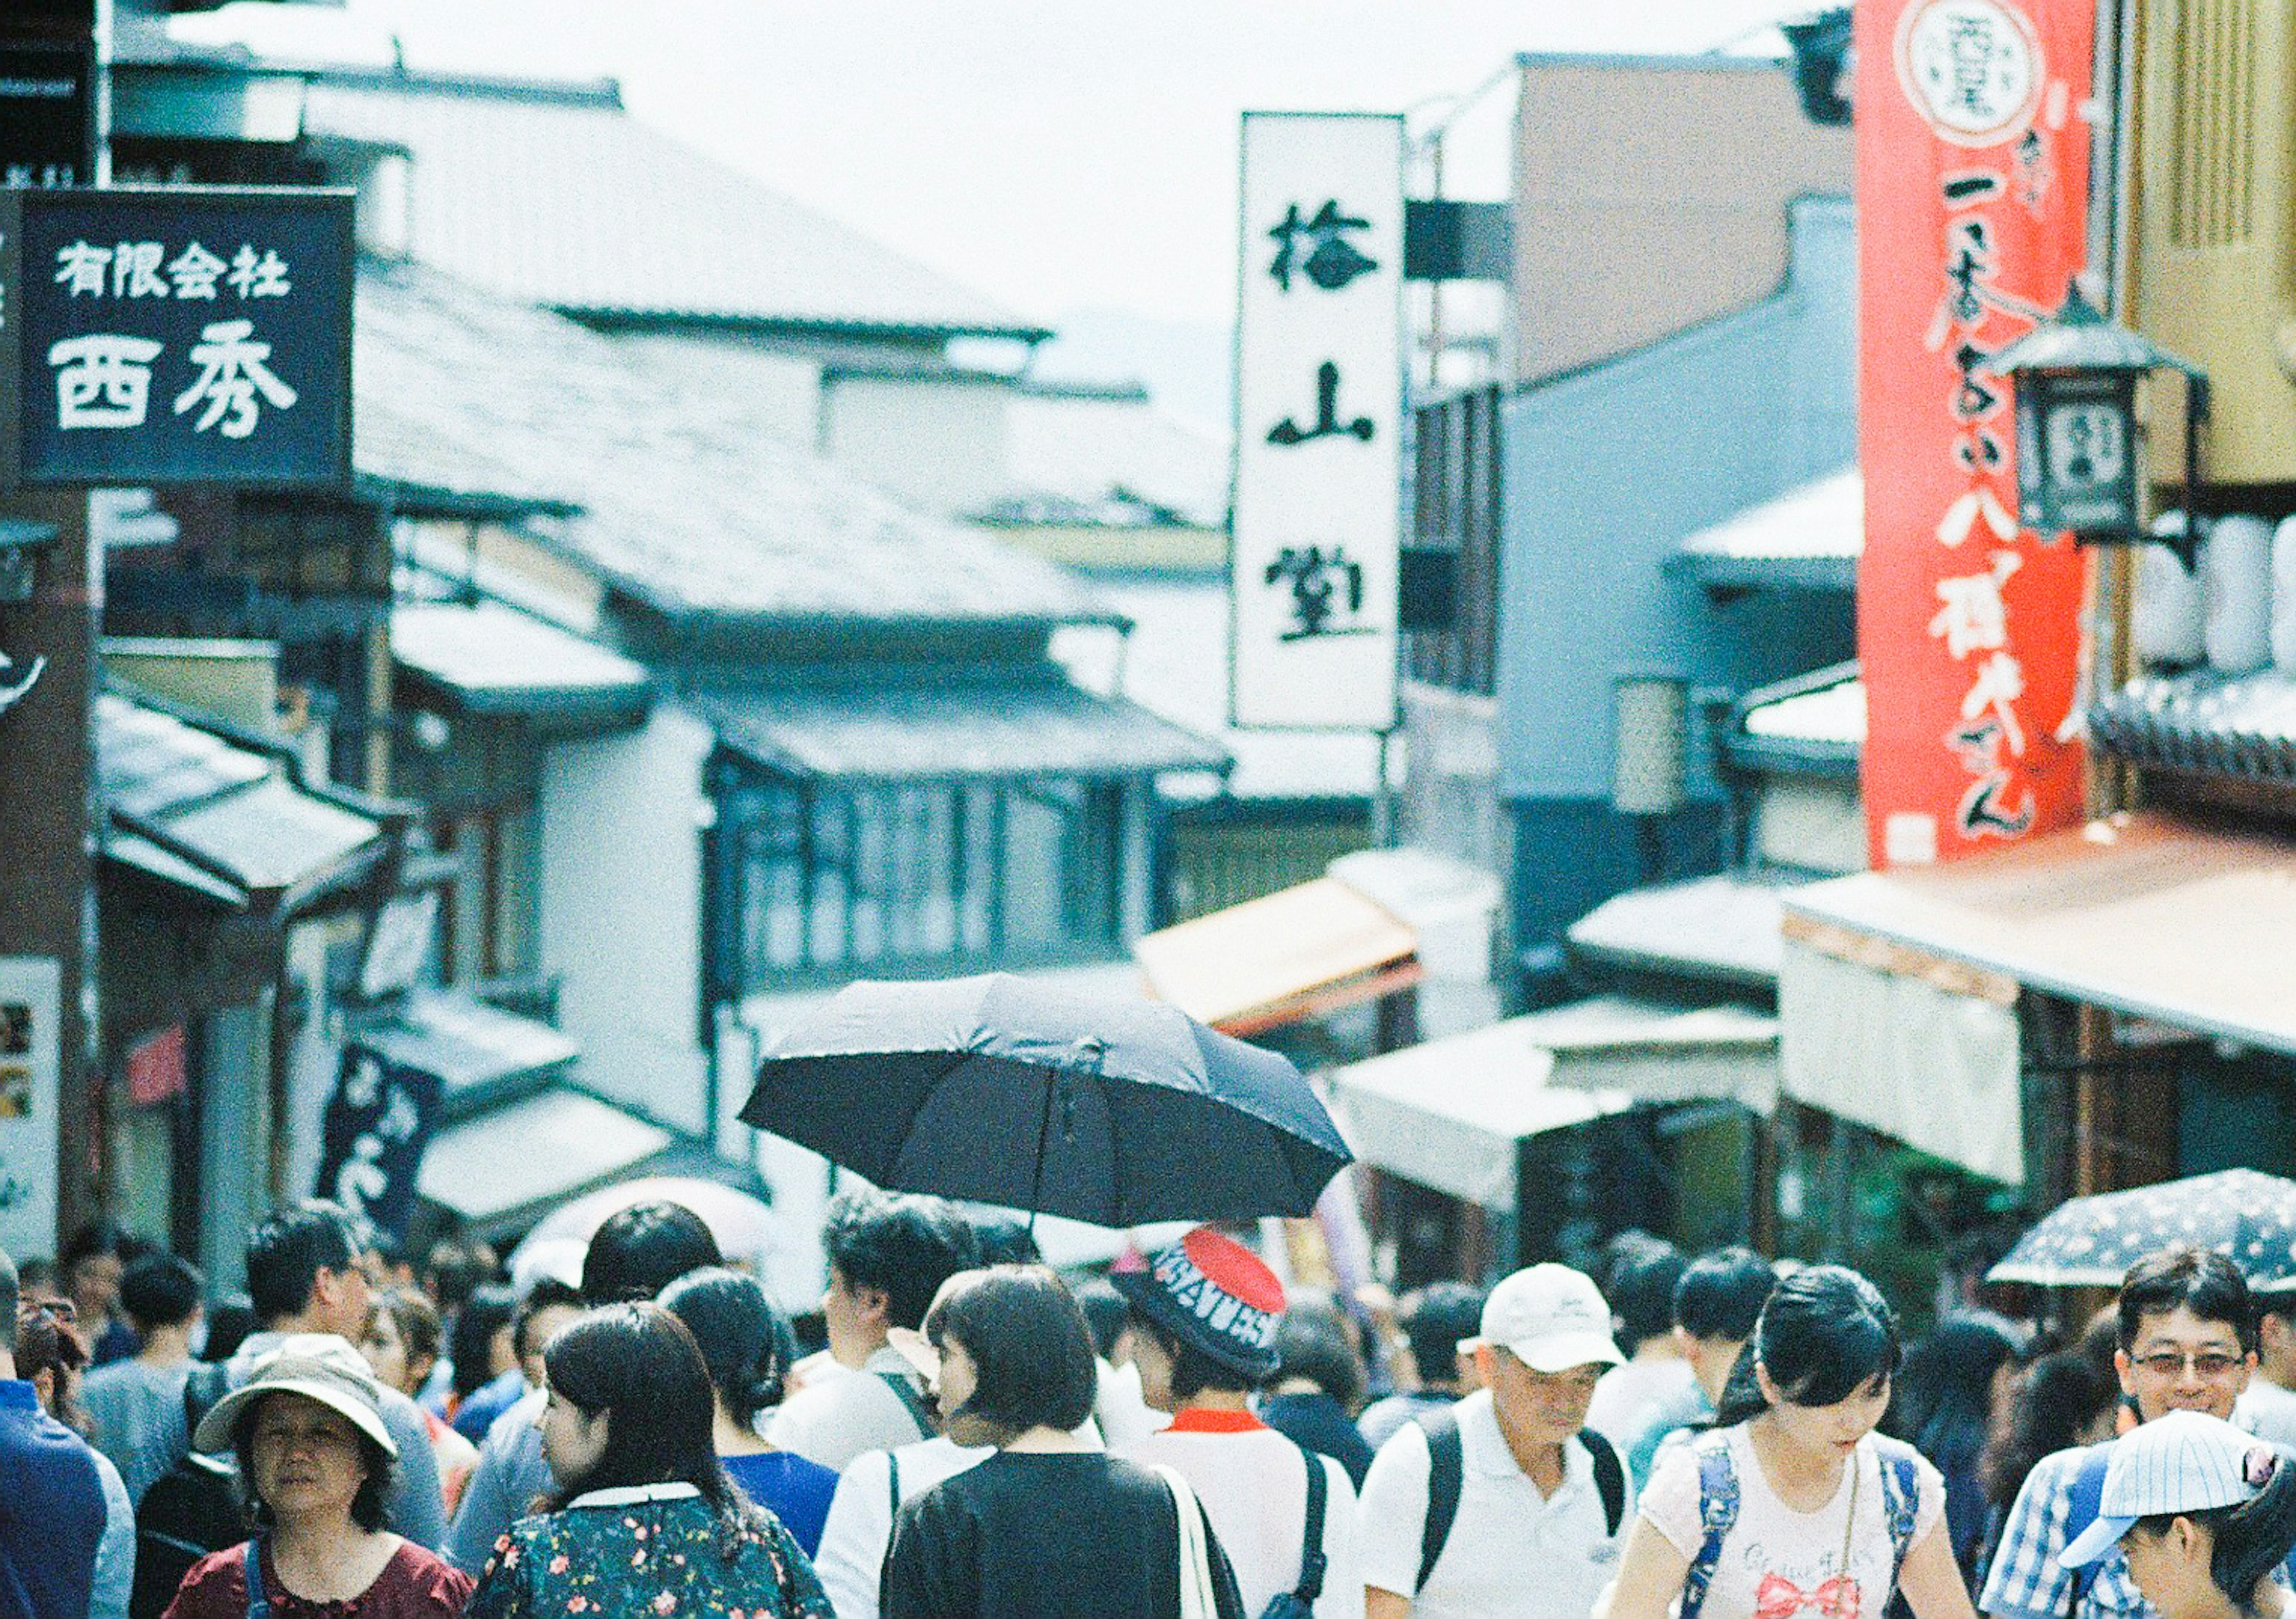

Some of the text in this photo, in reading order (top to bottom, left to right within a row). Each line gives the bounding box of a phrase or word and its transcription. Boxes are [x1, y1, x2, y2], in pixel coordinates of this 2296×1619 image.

[55, 241, 291, 300] 有限会社
[48, 319, 298, 438] 西秀
[1265, 198, 1379, 643] 梅山堂
